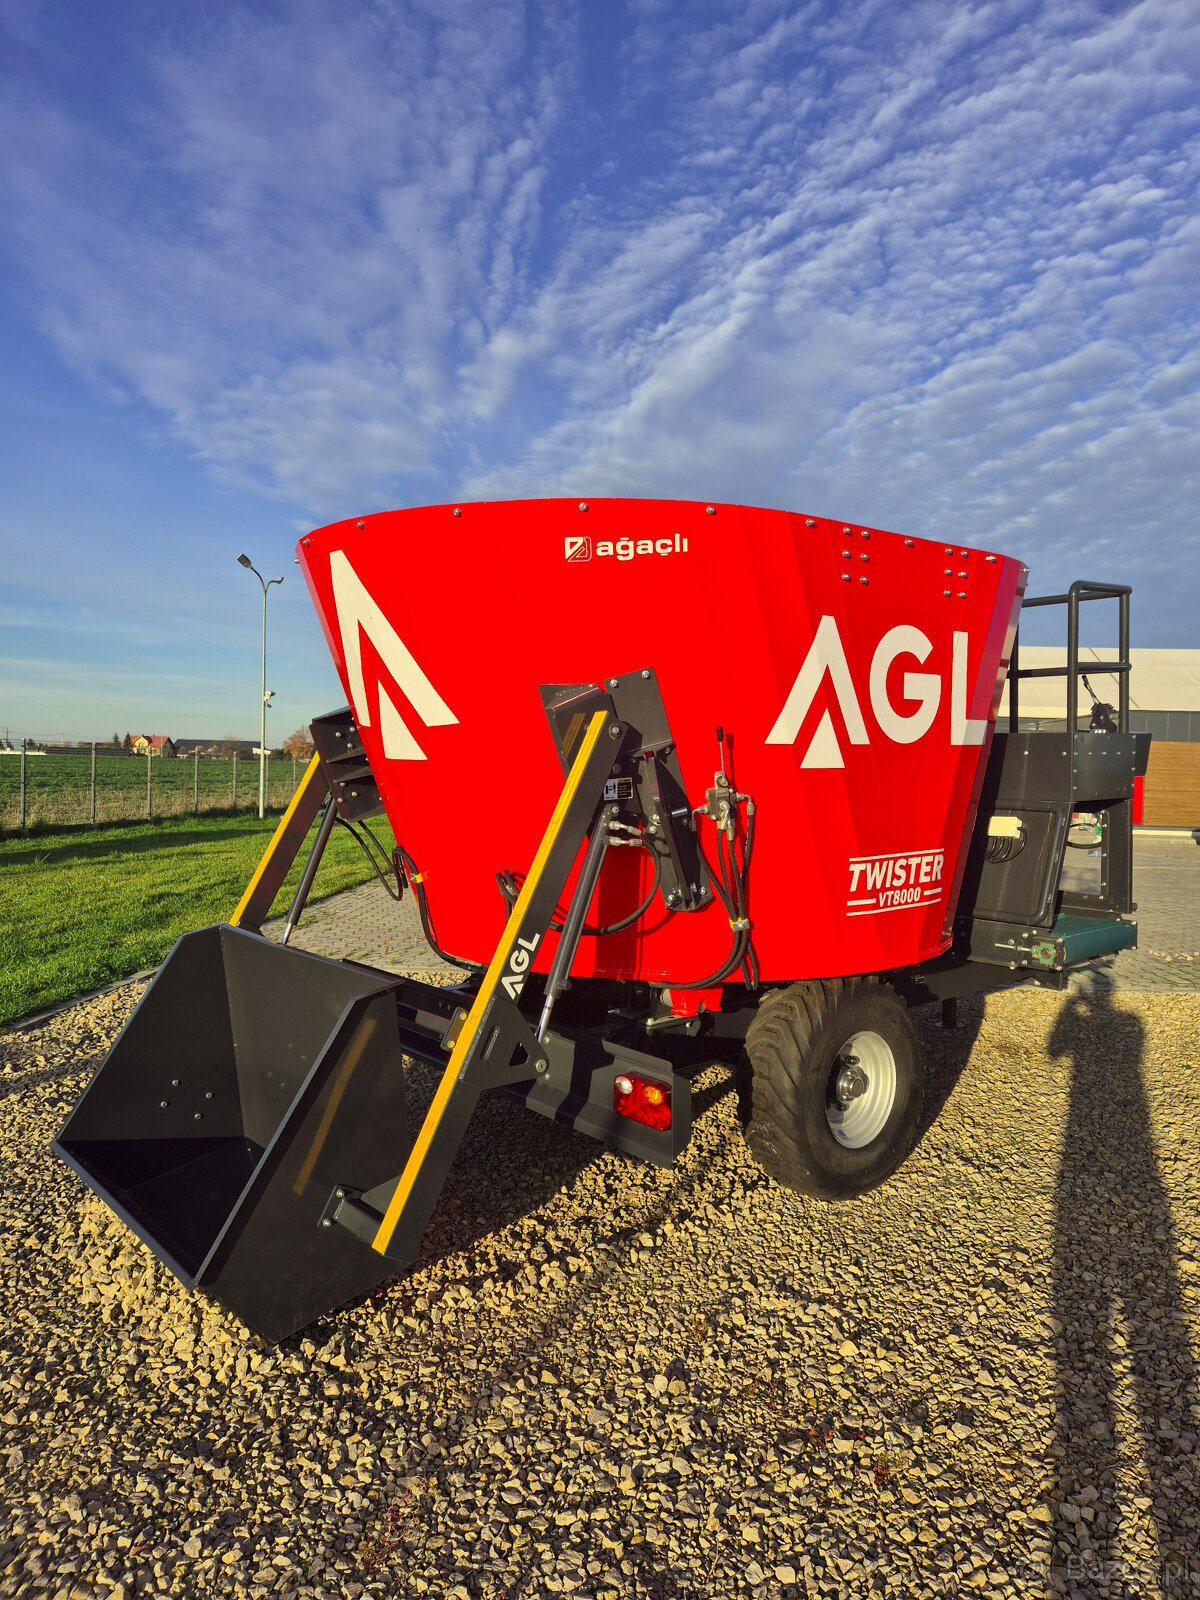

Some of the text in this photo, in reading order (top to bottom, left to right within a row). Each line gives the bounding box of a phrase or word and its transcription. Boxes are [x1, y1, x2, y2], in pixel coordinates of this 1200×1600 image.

[595, 533, 689, 561] ağaçlı
[764, 615, 988, 769] AGL
[848, 854, 944, 892] TWISTER
[878, 886, 921, 908] VT8000
[501, 933, 541, 1000] AGL
